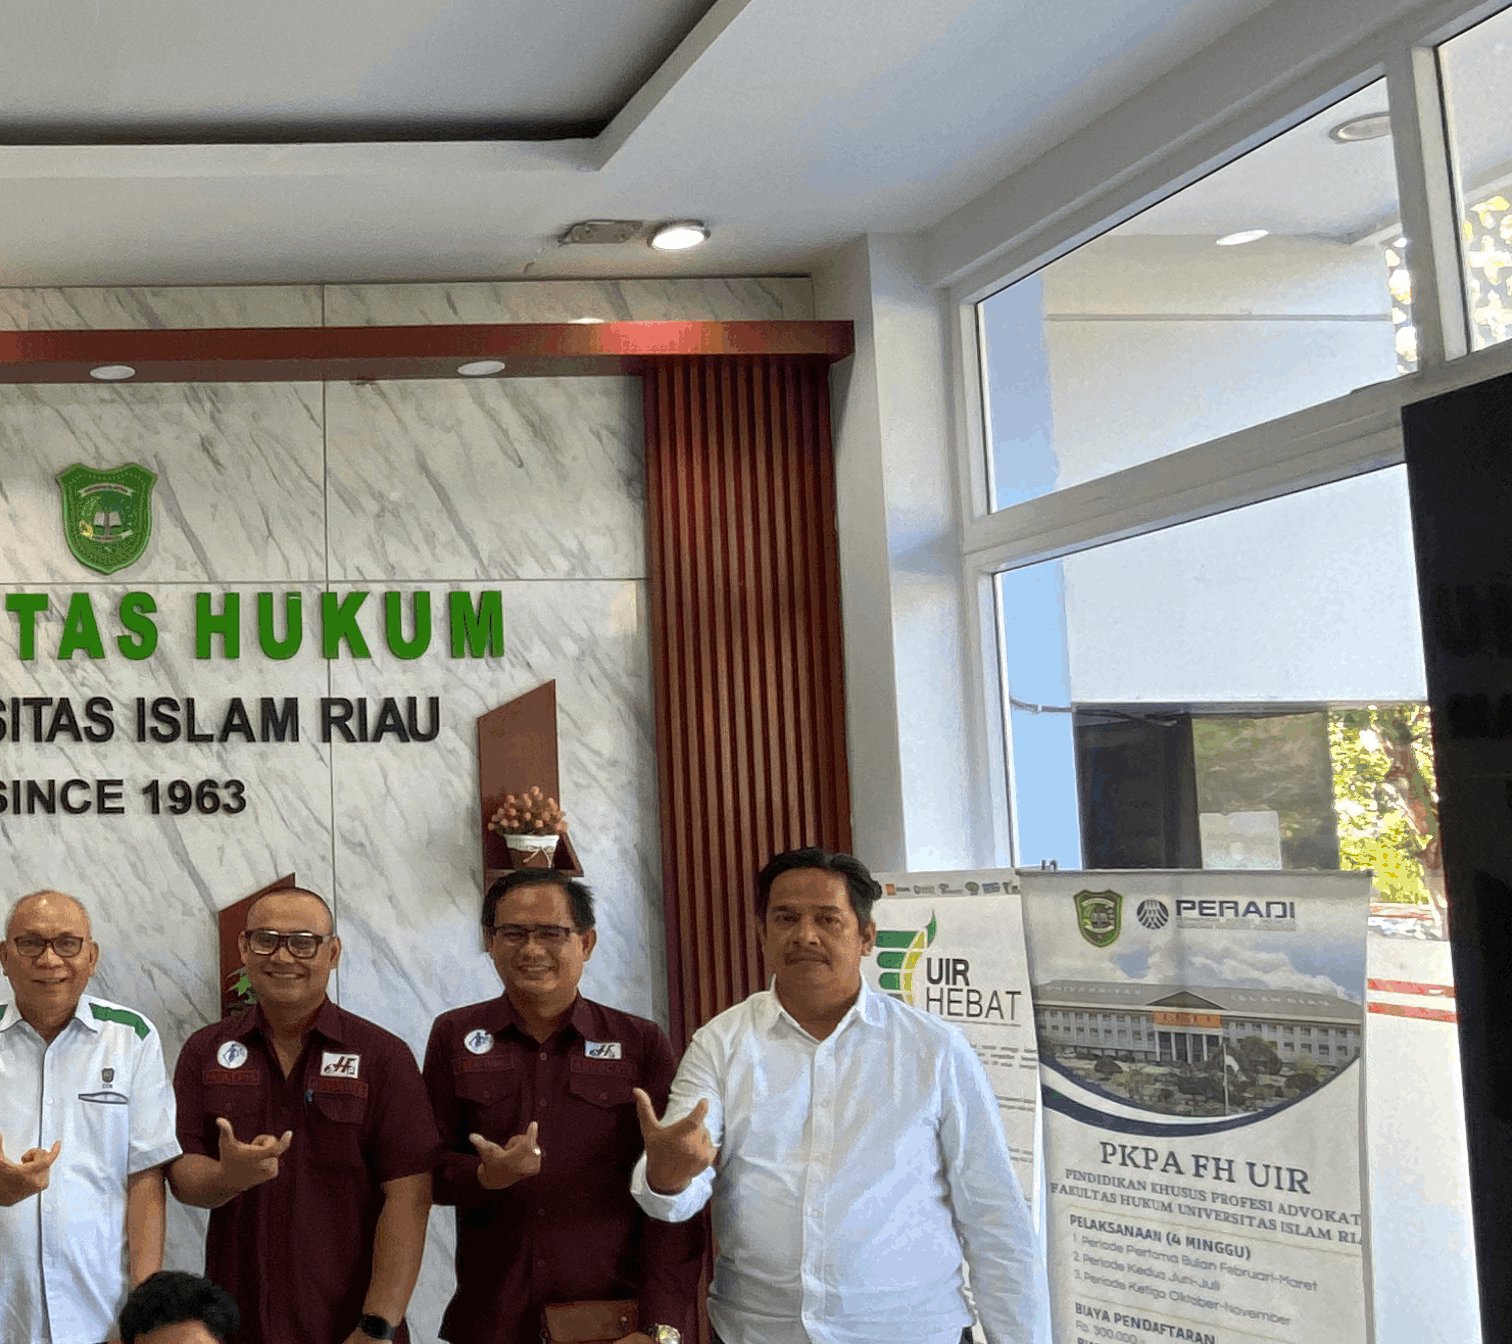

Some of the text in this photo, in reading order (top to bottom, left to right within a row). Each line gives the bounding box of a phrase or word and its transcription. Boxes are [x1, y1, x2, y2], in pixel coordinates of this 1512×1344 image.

[195, 590, 505, 662] HUKUM
[136, 696, 299, 743] ISLAM
[321, 695, 442, 743] RIAU
[142, 778, 248, 815] 1963
[1175, 899, 1296, 919] PERADI
[926, 957, 970, 986] UIR
[926, 987, 1022, 1021] HEBAT
[1099, 1141, 1311, 1194] PKPA FH UIR
[1050, 1182, 1117, 1204] FAKULTAS
[1120, 1194, 1174, 1213] HUKUM
[1177, 1203, 1277, 1231] UNIVERSITAS
[1280, 1220, 1333, 1241] ISLAM
[1065, 1168, 1361, 1226] PENDIDIKAN KHUSUS PROFESI ADVOKAT
[1069, 1213, 1251, 1261] PELAKSANAAN (4 MINGGU)
[1074, 1302, 1111, 1323] BIAYA
